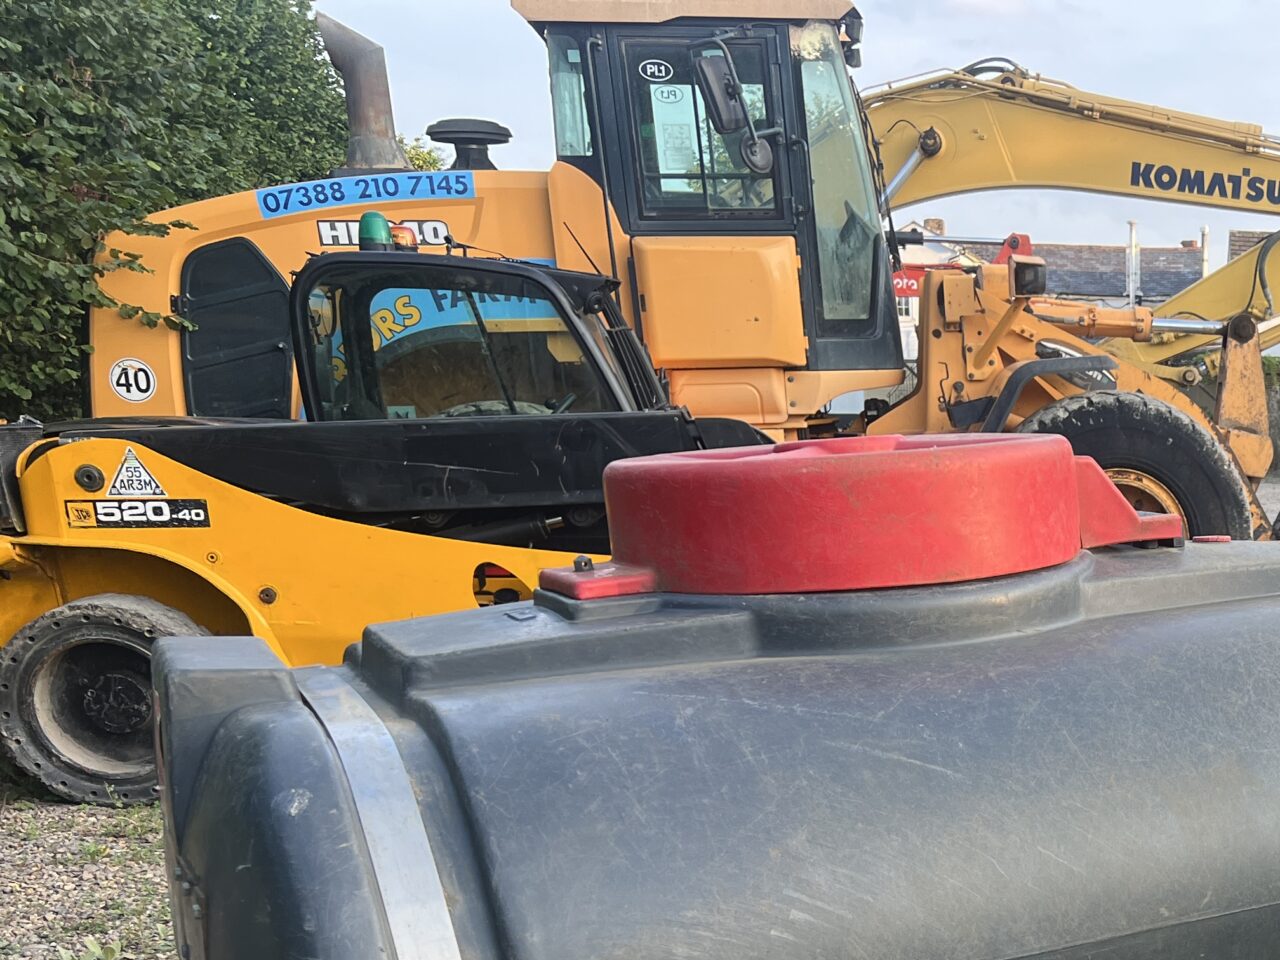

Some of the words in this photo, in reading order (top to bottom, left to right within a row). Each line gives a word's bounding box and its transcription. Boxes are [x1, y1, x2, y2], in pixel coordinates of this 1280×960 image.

[646, 64, 666, 76] PL1
[262, 181, 346, 213] 07388
[354, 176, 399, 199] 210
[407, 174, 469, 195] 7145
[318, 220, 450, 246] H40
[115, 367, 151, 393] 40
[125, 466, 142, 478] 55
[95, 501, 205, 522] 520-40
